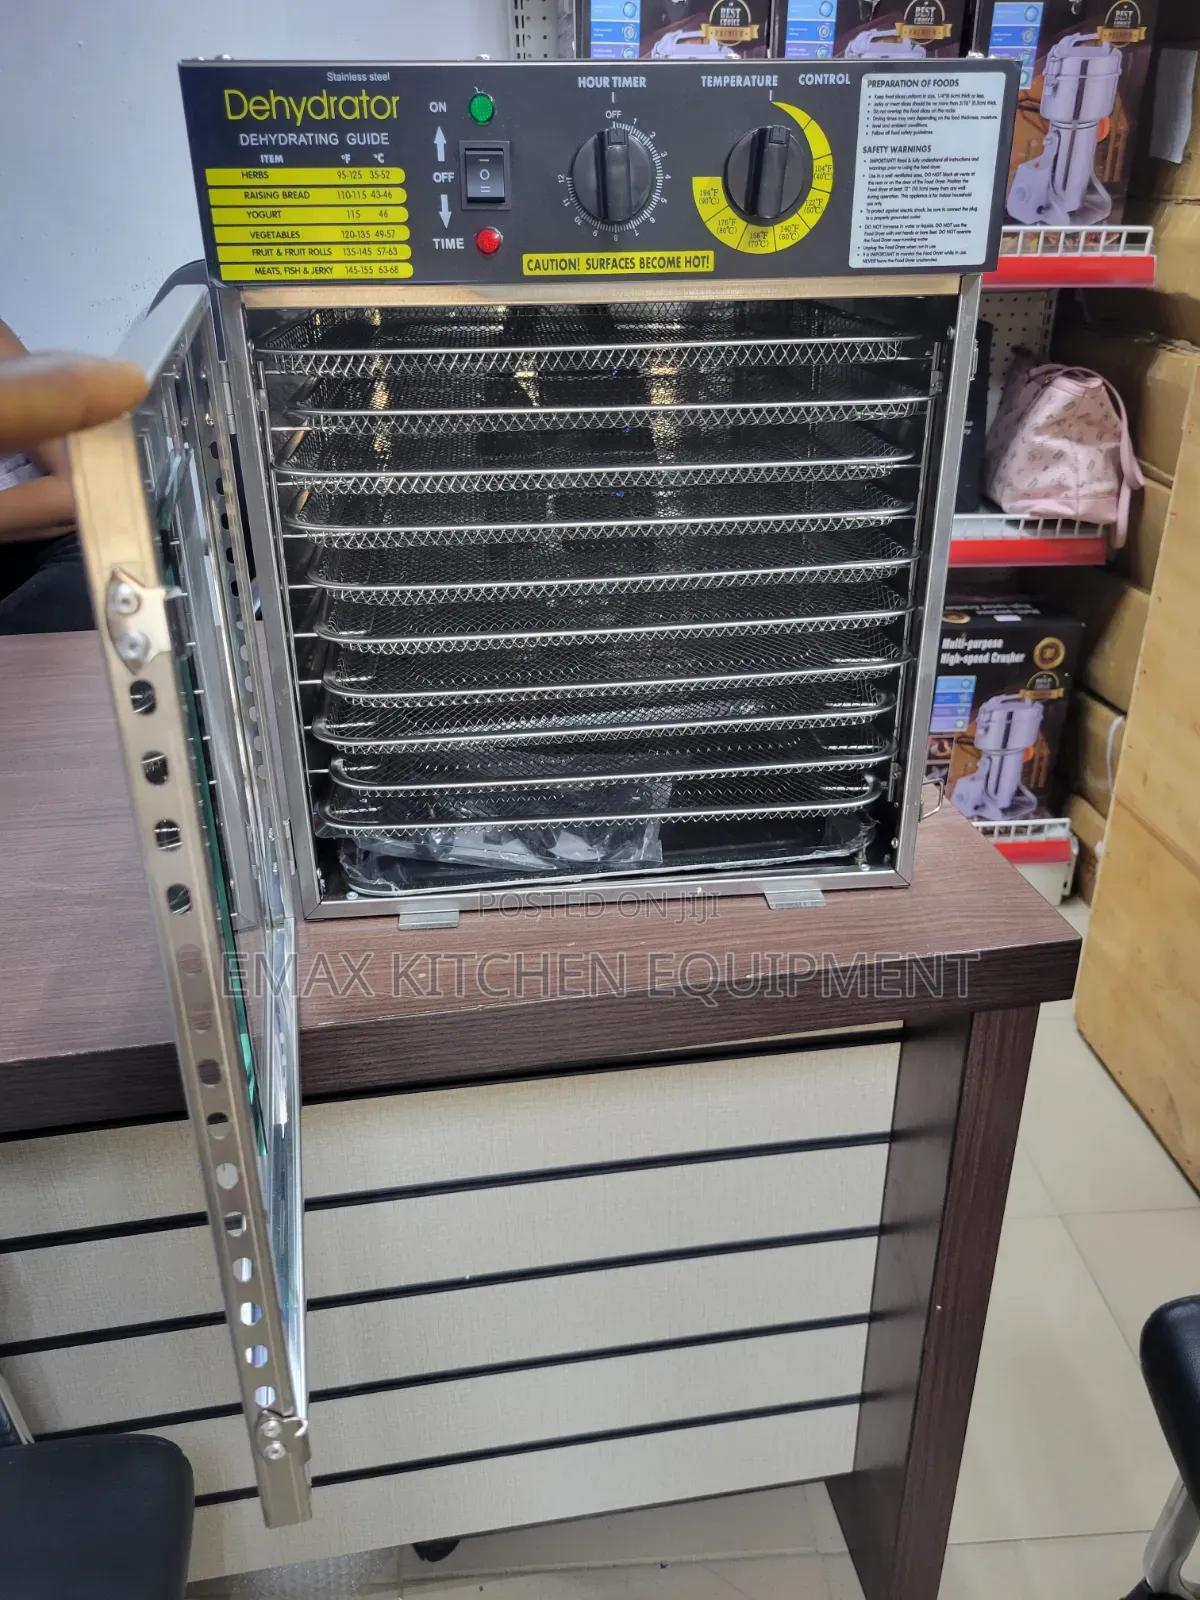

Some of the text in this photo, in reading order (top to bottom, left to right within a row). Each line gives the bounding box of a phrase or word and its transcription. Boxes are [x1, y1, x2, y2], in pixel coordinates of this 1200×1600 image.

[720, 8, 742, 19] BEST
[915, 7, 937, 17] BEST
[1114, 10, 1133, 21] BEST
[327, 72, 390, 81] Stainless steel
[701, 74, 851, 88] TEMPERATURE CONTROL
[578, 76, 647, 88] HOUR TIMER
[868, 80, 919, 88] PREPARATION
[933, 79, 959, 87] FOODS
[224, 89, 400, 126] Dehydrator
[430, 102, 447, 113] ON
[606, 110, 622, 119] OFF
[240, 133, 389, 146] DEHYDRATING GUIDE
[890, 145, 931, 153] WARNINGS
[260, 154, 283, 164] ITEM
[241, 170, 391, 180] HERBS 95-125 35-52
[432, 172, 455, 183] OFF
[558, 174, 565, 183] 12
[244, 190, 393, 200] RAISING BREAD 110-115 43-46
[562, 199, 571, 207] 11
[246, 210, 389, 219] YOGURT 115 46
[574, 218, 583, 226] 10
[250, 230, 396, 240] VEGETABLES 120-135 49-57
[614, 234, 619, 242] 8
[432, 238, 465, 250] TIME
[252, 247, 398, 257] FRUIT & FRUIT ROLLS 135-145 57-63
[527, 255, 710, 272] CAUTION! SURFACES BECOME HOT!
[254, 266, 399, 276] MEATS, FISH & JERKY 145-155 63-68
[942, 638, 1004, 651] Multi-purpose
[940, 652, 1026, 666] High-speed Crusher
